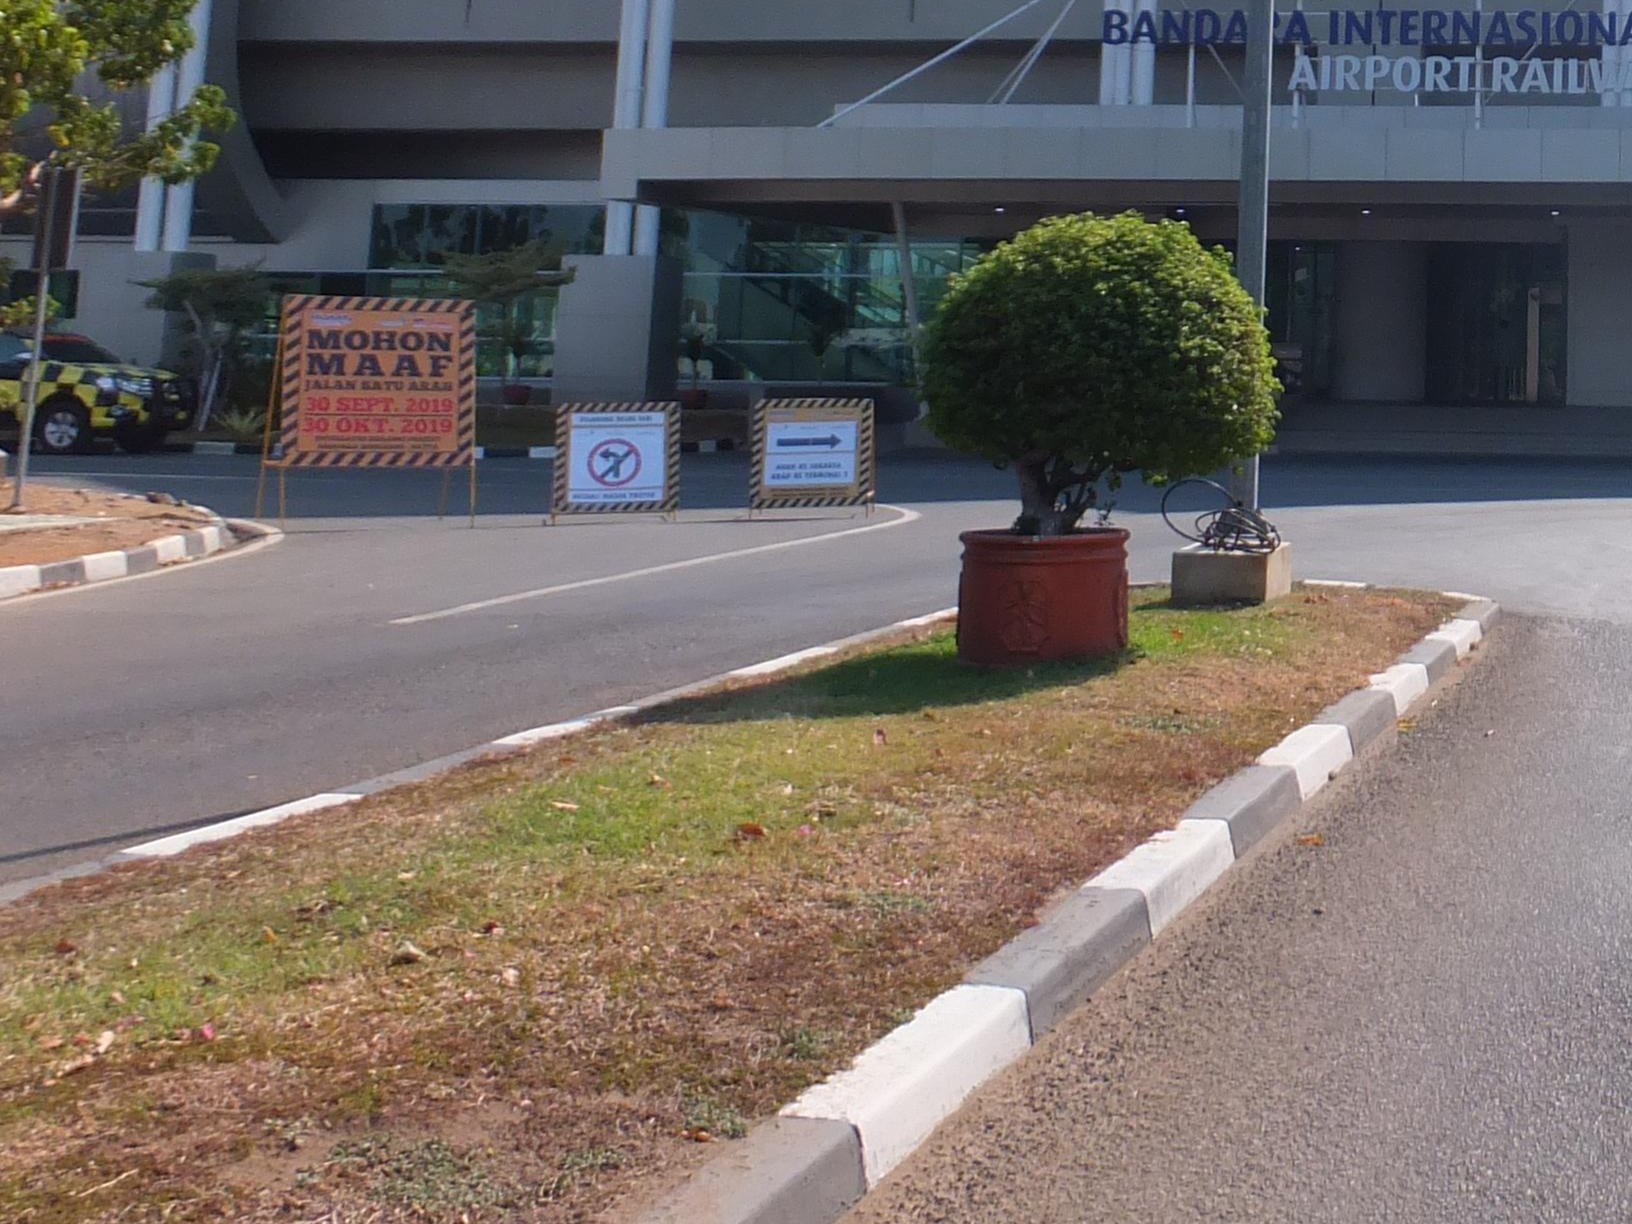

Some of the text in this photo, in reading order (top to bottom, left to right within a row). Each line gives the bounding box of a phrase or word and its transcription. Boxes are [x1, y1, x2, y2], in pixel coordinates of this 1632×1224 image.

[1288, 54, 1477, 92] AIRPORT
[306, 329, 453, 352] MOHON
[306, 352, 453, 377] MAAF
[304, 379, 355, 392] JALAN
[306, 396, 454, 414] 30 SEPT. 2019
[302, 417, 453, 434] 30 OKT. 2019
